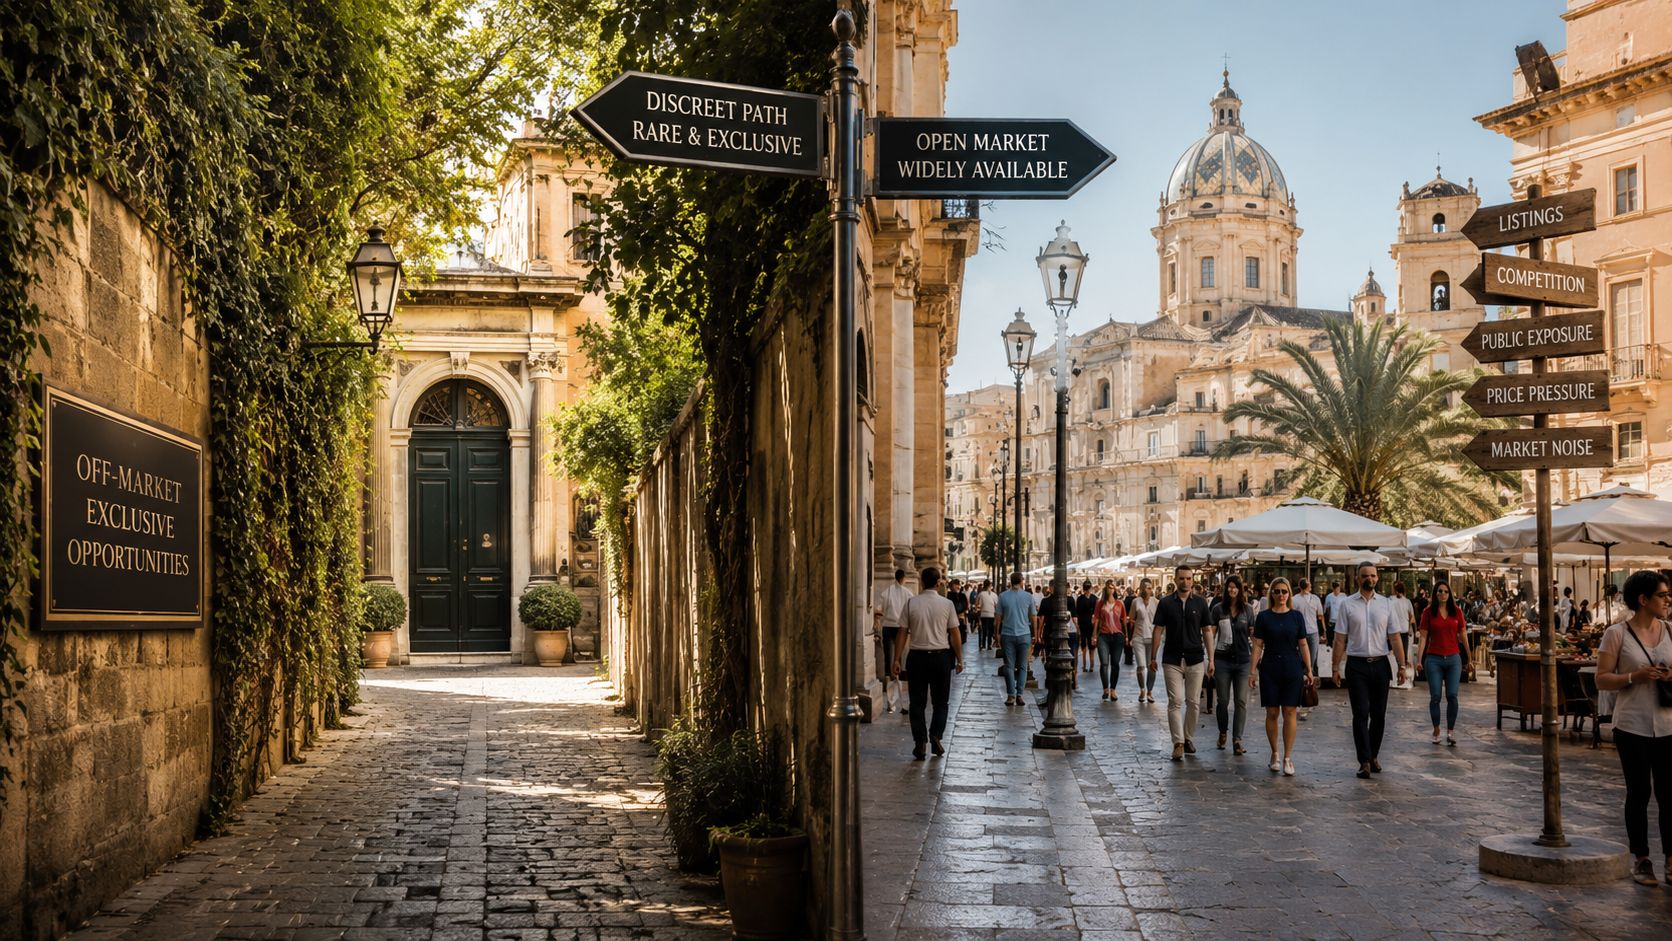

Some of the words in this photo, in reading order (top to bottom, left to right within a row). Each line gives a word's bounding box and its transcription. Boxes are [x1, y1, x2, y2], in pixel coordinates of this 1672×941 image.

[646, 91, 737, 120] DISCREET
[742, 103, 788, 126] PATH
[632, 120, 683, 144] RARE
[688, 126, 701, 146] &
[707, 128, 802, 156] EXCLUSIVE
[916, 133, 967, 151] OPEN
[973, 133, 1050, 151] MARKET
[897, 160, 967, 179] WIDELY
[971, 160, 1068, 179] AVAILABLE
[1499, 205, 1564, 232] LISTINGS
[1497, 266, 1585, 294] COMPETITION
[1481, 330, 1524, 350] PUBLIC
[1528, 324, 1594, 346] EXPOSURE
[1487, 386, 1525, 404] PRICE
[1529, 382, 1596, 402] PRESSURE
[1491, 440, 1548, 458] MARKET
[1552, 438, 1594, 456] NOISE
[76, 453, 182, 504] OFF-MARKET
[86, 497, 175, 539] EXCLUSIVE
[67, 538, 190, 576] OPPORTUNITIES
